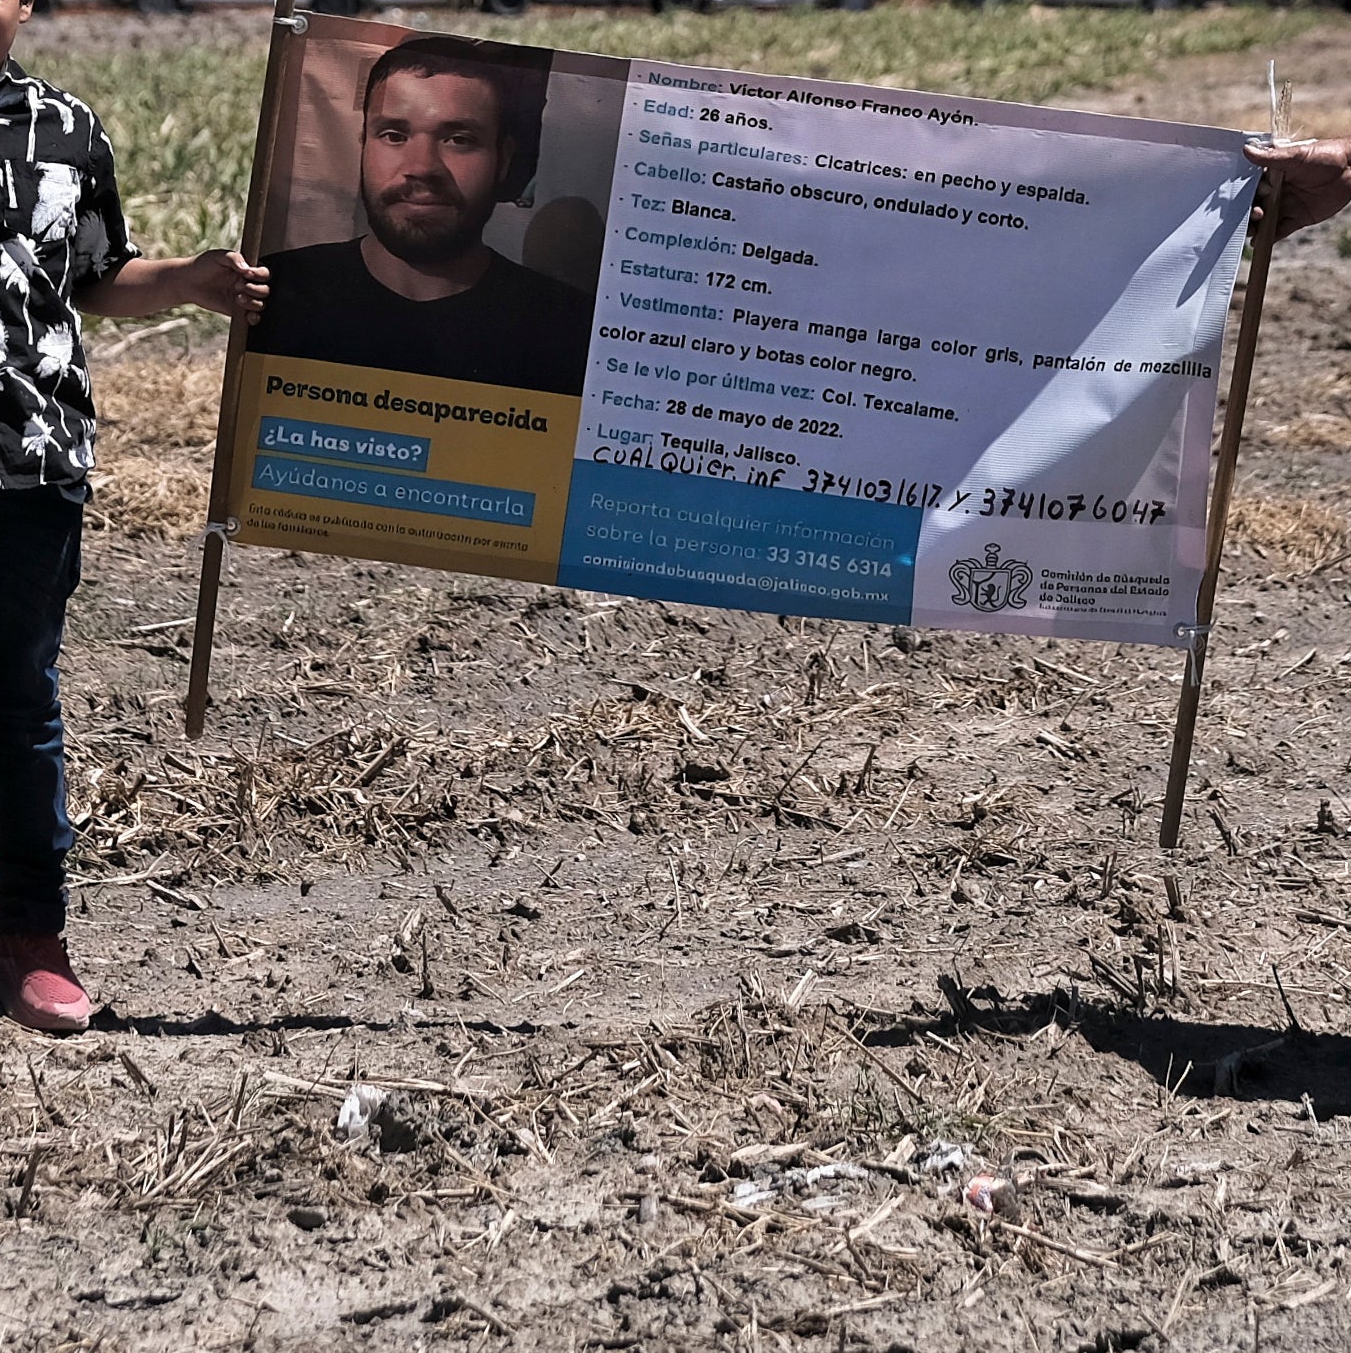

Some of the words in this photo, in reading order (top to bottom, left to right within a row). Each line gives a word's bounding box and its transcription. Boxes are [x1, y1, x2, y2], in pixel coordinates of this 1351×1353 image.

[644, 99, 694, 119] Edad:
[699, 108, 720, 122] 26
[725, 112, 773, 131] años.
[649, 72, 723, 93] Nombre:
[729, 83, 782, 100] Víctor
[787, 90, 856, 109] Alfonso
[861, 99, 923, 118] Franco
[927, 107, 978, 126] Ayón.
[639, 130, 691, 149] Señas
[698, 139, 808, 166] particulares:
[815, 154, 907, 179] Cicatrices:
[914, 170, 936, 183] en
[942, 172, 996, 192] pecho
[1000, 182, 1011, 197] y
[1016, 184, 1090, 205] espalda.
[631, 193, 665, 212] Tez:
[671, 199, 736, 222] Blanca.
[634, 161, 706, 184] Cabello:
[712, 172, 784, 195] Castaño
[790, 183, 867, 209] obscuro,
[873, 196, 958, 219] ondulado
[962, 209, 973, 225] y
[977, 211, 1029, 230] corto.
[625, 226, 737, 255] Complexión:
[742, 242, 818, 267] Delgada.
[620, 260, 699, 284] Estatura:
[706, 272, 736, 289] 172
[741, 279, 772, 295] cm.
[599, 326, 646, 343] color
[649, 332, 686, 349] azul
[691, 337, 735, 355] claro
[740, 346, 751, 361] y
[756, 345, 805, 366] botas
[809, 355, 856, 374] color
[860, 363, 917, 383] negro.
[620, 292, 724, 321] Vestimenta:
[732, 308, 799, 332] Playera
[808, 322, 868, 344] manga
[877, 329, 921, 350] larga
[931, 339, 978, 357] color
[985, 347, 1023, 366] gris,
[1032, 353, 1105, 373] pantalón
[1114, 359, 1132, 373] de
[1139, 360, 1212, 378] mezclilla
[266, 375, 368, 408] Persona
[374, 390, 548, 433] desaparecida
[601, 390, 661, 412] Fecha:
[666, 399, 687, 416] 28
[692, 403, 714, 419] de
[718, 410, 766, 429] mayo
[771, 414, 794, 431] de
[798, 418, 844, 439] 2022.
[606, 358, 629, 374] Se
[634, 361, 649, 377] le
[654, 364, 680, 381] vio
[686, 371, 717, 387] por
[722, 372, 775, 395] última
[781, 384, 815, 401] vez:
[822, 388, 857, 408] Col.
[863, 393, 959, 422] Texcalame.
[264, 425, 304, 446] ¿La
[310, 431, 349, 452] has
[355, 437, 423, 462] visto?
[597, 423, 653, 445] Lugar:
[660, 432, 729, 458] Tequila,
[733, 443, 801, 467] Jalisco.
[258, 463, 368, 495] Ayúdanos
[374, 484, 388, 498] a
[395, 486, 525, 517] encontrarla
[590, 492, 671, 518] Reporta
[677, 510, 770, 533] cualquier
[775, 519, 895, 550] información
[586, 523, 644, 544] sobre
[649, 529, 668, 547] la
[674, 537, 762, 559] persona:
[766, 546, 790, 564] 33
[795, 550, 841, 571] 3145
[846, 557, 892, 577] 6314
[1110, 585, 1128, 595] del
